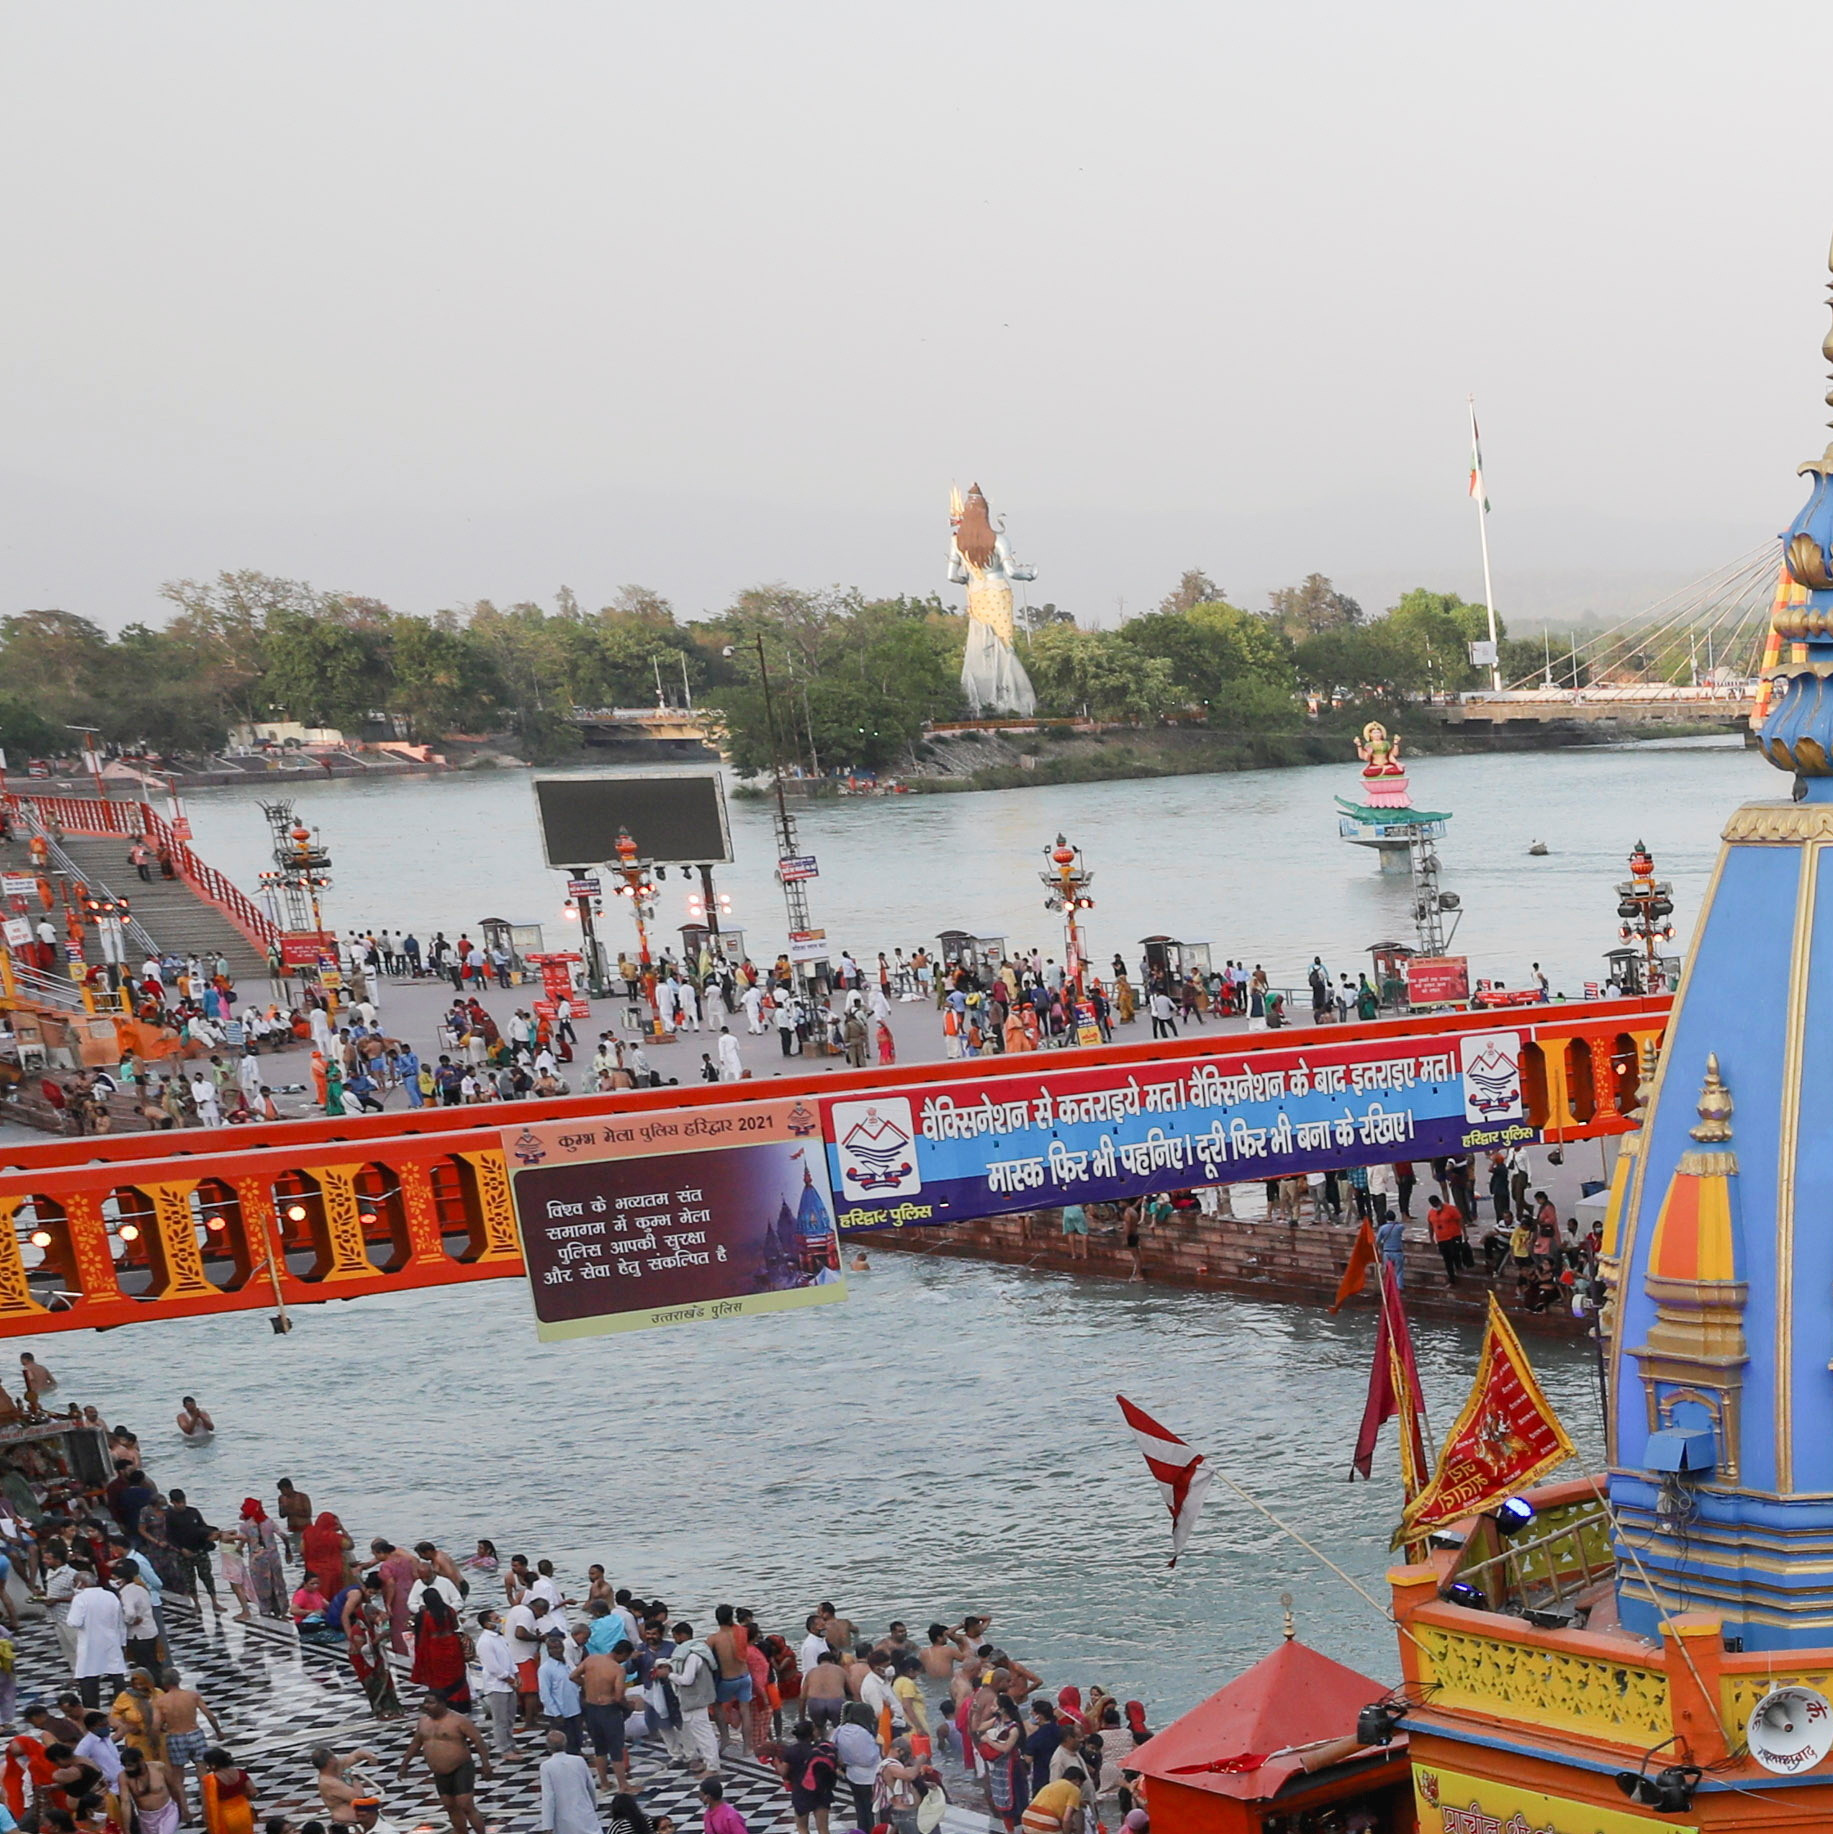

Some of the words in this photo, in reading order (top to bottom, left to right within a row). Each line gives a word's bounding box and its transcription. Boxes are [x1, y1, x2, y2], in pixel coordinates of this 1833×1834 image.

[920, 1094, 1029, 1142] वैक्सिनेशन
[1033, 1086, 1055, 1130] से
[1056, 1075, 1141, 1126] कतराइये
[1189, 1064, 1286, 1109] वैक्सिनेशन
[1289, 1057, 1309, 1097] के
[1313, 1065, 1347, 1095] बाद
[1350, 1060, 1416, 1096] इतराइए
[558, 1133, 595, 1151] कुम्भ
[603, 1126, 634, 1144] मेला
[640, 1122, 679, 1143] पुलिस
[683, 1118, 732, 1139] हरिद्वार
[738, 1115, 773, 1131] 2021
[985, 1156, 1045, 1193] मास्क
[1091, 1135, 1118, 1179] भी
[1195, 1119, 1228, 1179] दूरी
[1230, 1117, 1267, 1161] फिर
[1270, 1112, 1293, 1154] भी
[1296, 1120, 1332, 1152] बना
[1335, 1107, 1355, 1147] के
[1461, 1129, 1500, 1148] हरिद्वार
[1501, 1125, 1534, 1146] पुलिस
[546, 1199, 584, 1219] विश्व
[590, 1194, 608, 1214] के
[615, 1193, 669, 1210] भव्यतम
[676, 1185, 703, 1204] संत
[839, 1206, 889, 1228] हरिद्वार
[891, 1203, 932, 1226] पुलिस
[545, 1222, 606, 1241] समागम
[613, 1214, 628, 1233] में
[635, 1213, 672, 1234] कुम्भ
[679, 1207, 711, 1225] मेला
[557, 1244, 601, 1265] पुलिस
[609, 1232, 657, 1256] आपकी
[663, 1230, 707, 1248] सुरक्षा
[543, 1268, 573, 1286] और
[579, 1262, 610, 1281] सेवा
[617, 1257, 641, 1276] हेतु
[647, 1250, 710, 1272] संकल्पित
[717, 1244, 727, 1262] है
[651, 1306, 705, 1324] उत्तराखंड
[711, 1301, 743, 1319] पुलिस
